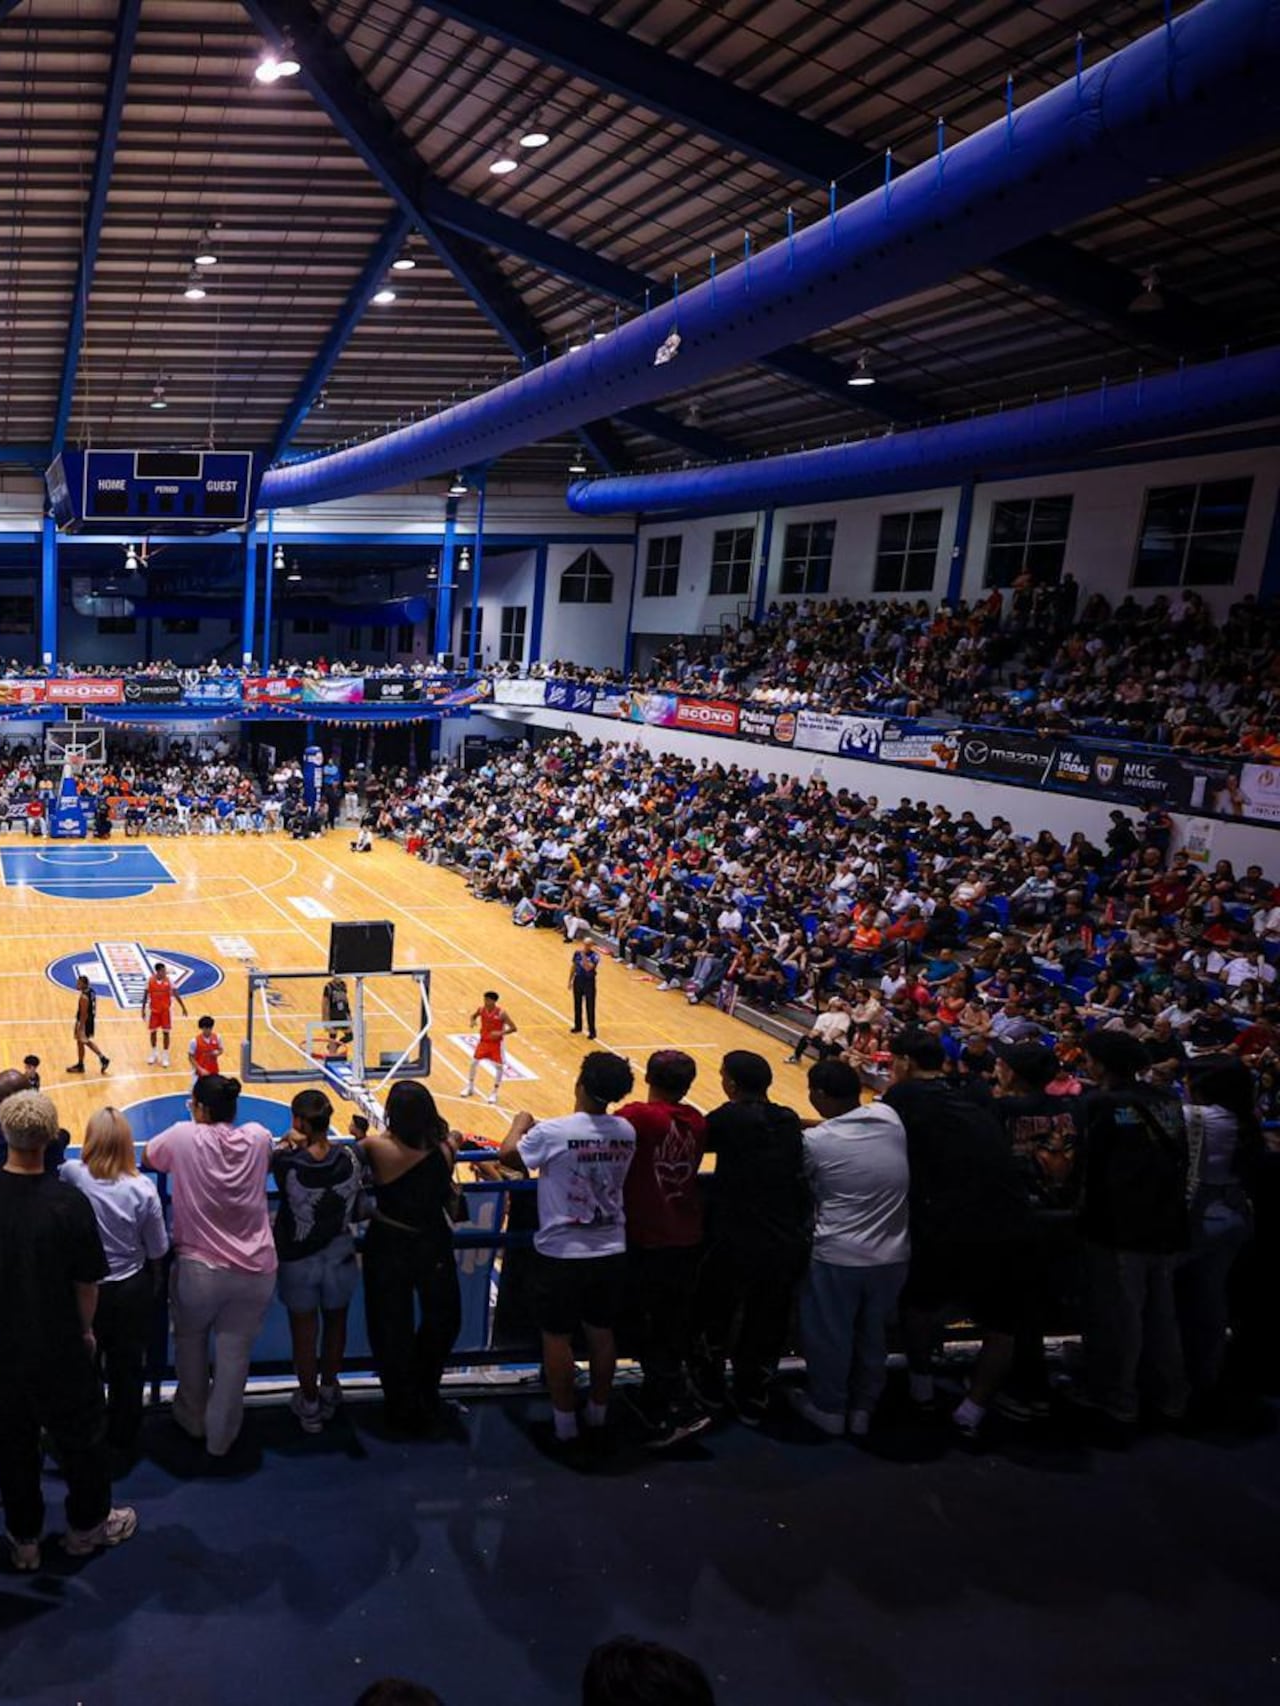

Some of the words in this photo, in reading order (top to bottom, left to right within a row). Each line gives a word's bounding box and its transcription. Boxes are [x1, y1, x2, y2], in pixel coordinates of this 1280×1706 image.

[98, 479, 126, 491] HOME
[154, 485, 180, 494] PERIOD
[206, 480, 238, 492] GUEST
[51, 686, 117, 698] ECONO
[680, 707, 733, 723] ECONO
[1123, 762, 1156, 779] NUC
